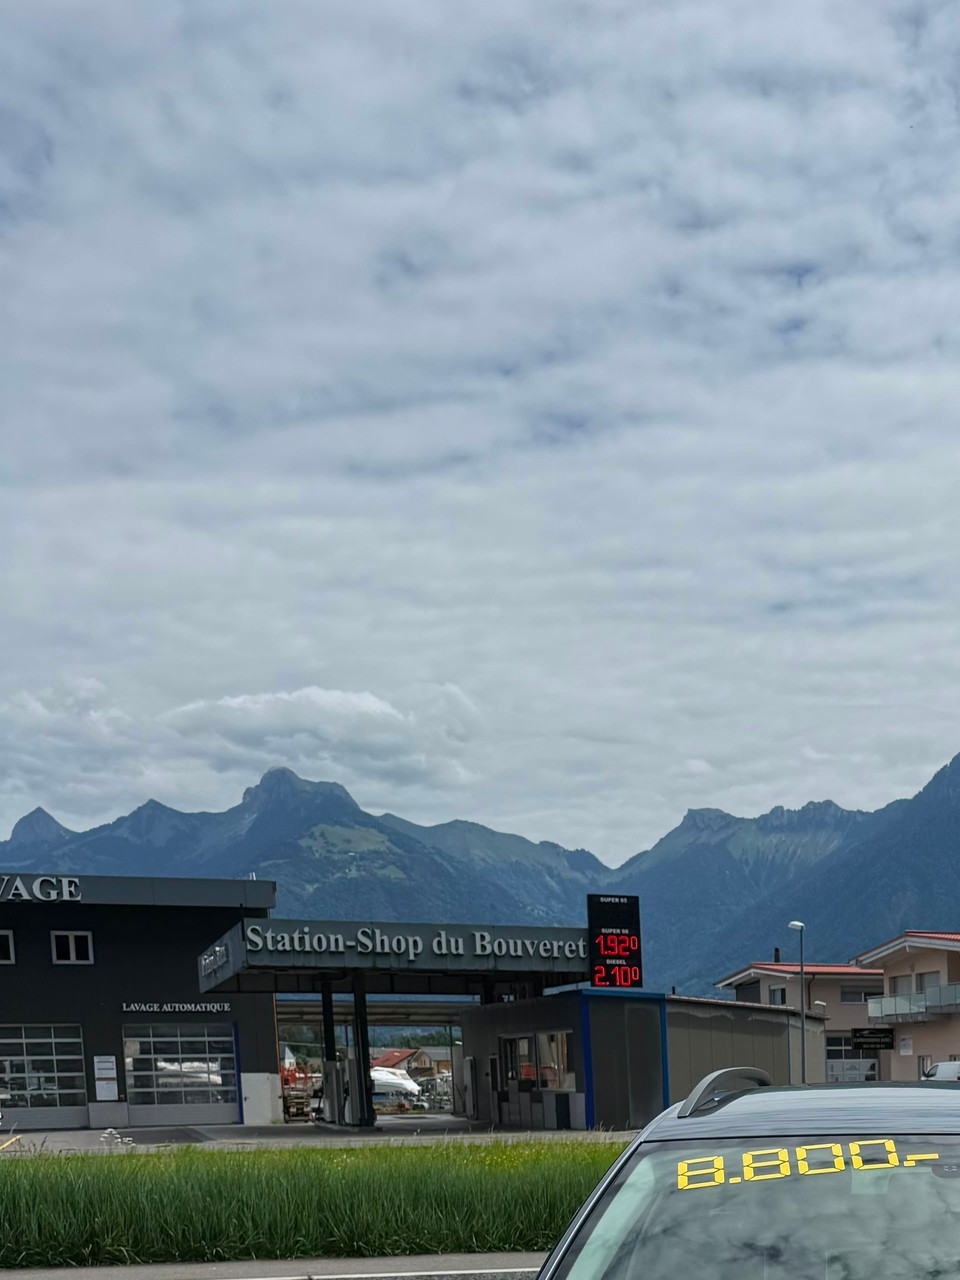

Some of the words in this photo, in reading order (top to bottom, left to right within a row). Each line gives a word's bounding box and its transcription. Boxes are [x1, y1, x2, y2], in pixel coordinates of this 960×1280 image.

[246, 925, 423, 961] Station-Shop
[432, 930, 465, 955] du
[472, 931, 588, 958] Bouveret
[122, 1003, 160, 1012] LAVAGE
[161, 1003, 231, 1013] AUTOMATIQUE
